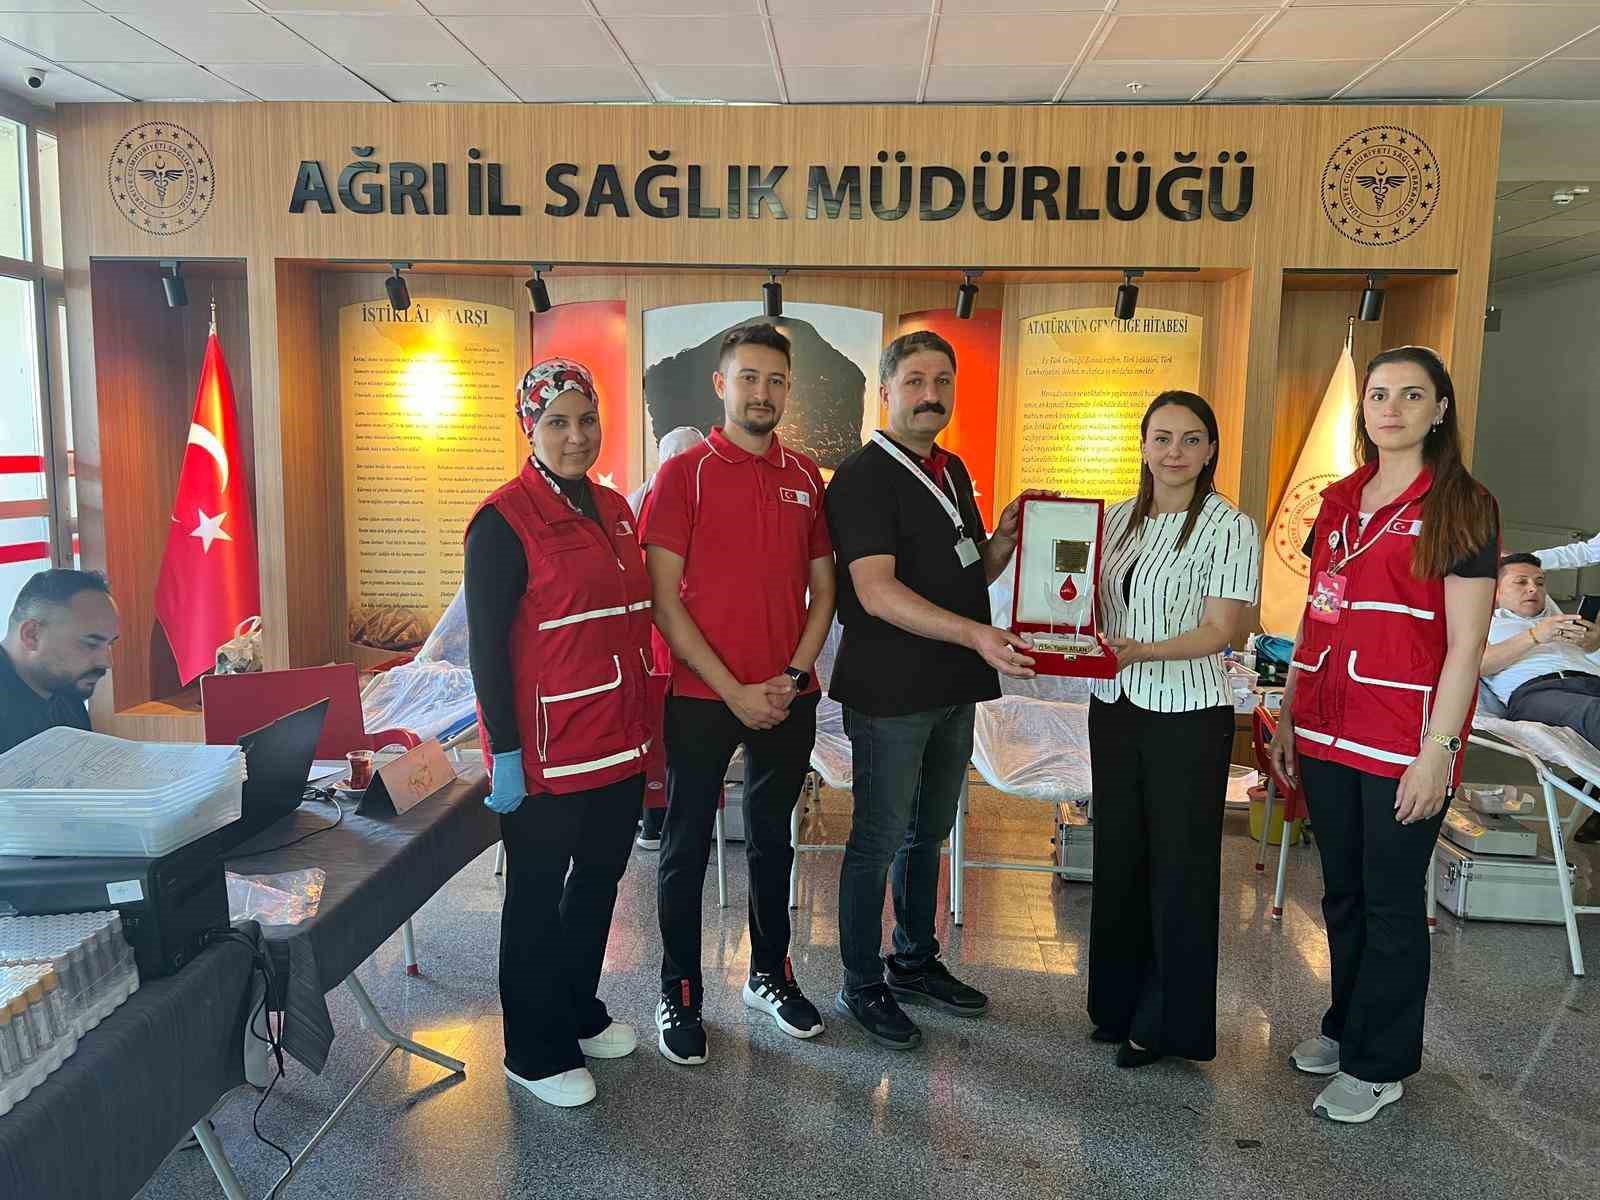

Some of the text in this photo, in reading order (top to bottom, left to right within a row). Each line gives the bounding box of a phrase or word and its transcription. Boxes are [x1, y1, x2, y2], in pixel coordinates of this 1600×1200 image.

[288, 146, 1255, 222] AĞRI İL SAĞLIK MÜDÜRLÜĞÜ
[1143, 315, 1189, 334] HİTABESİ
